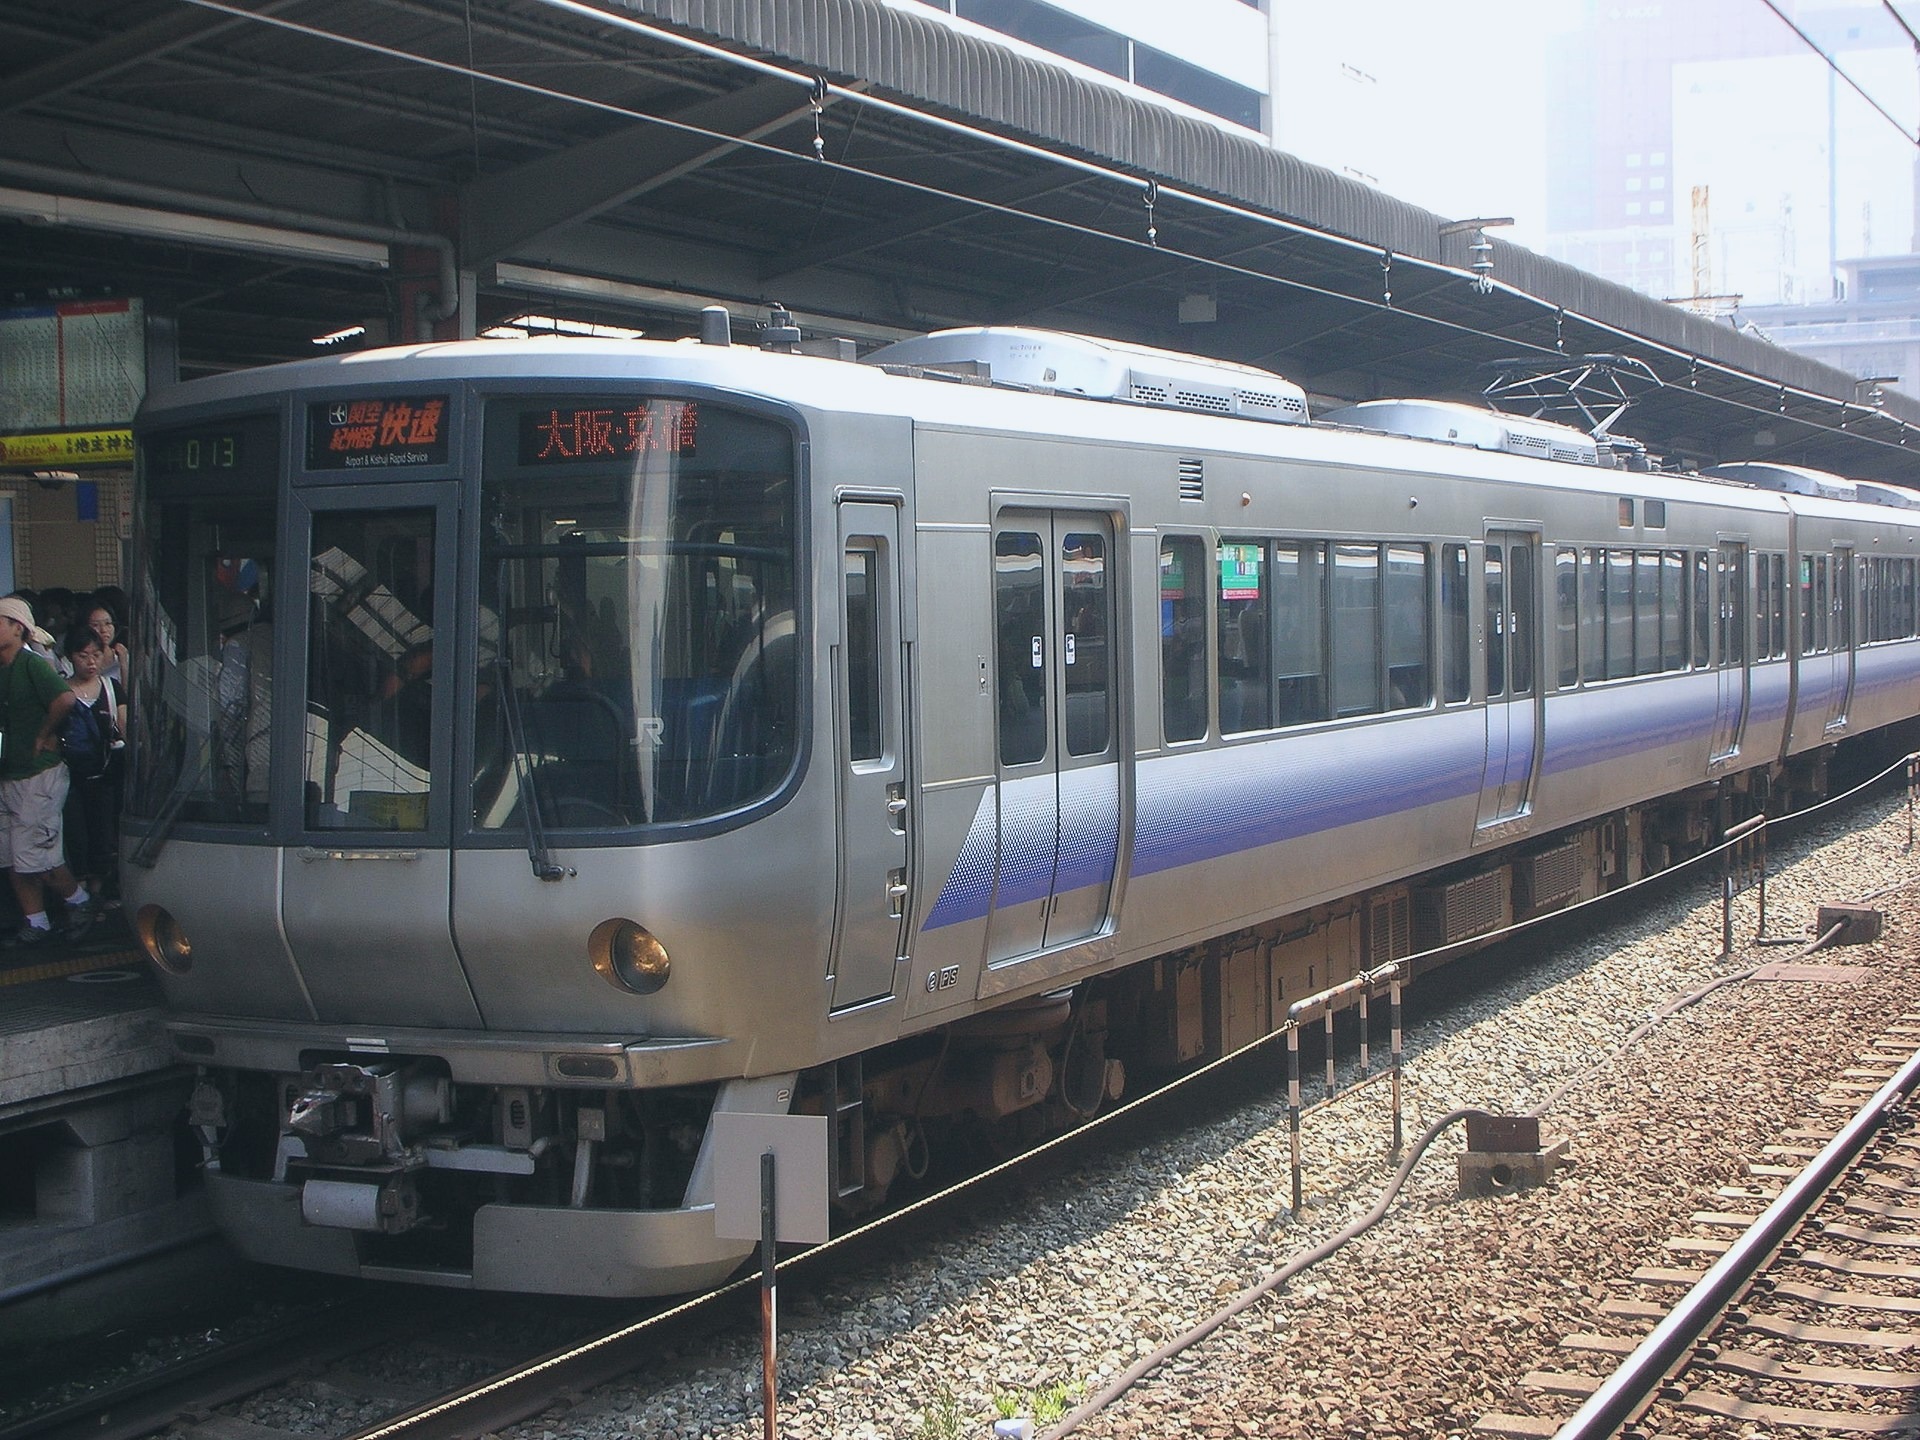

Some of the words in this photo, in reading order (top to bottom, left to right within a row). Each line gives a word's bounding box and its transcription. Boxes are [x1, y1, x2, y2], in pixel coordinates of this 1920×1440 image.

[380, 400, 444, 446] 快速
[345, 456, 363, 468] Airport
[390, 452, 406, 464] Rapid
[407, 452, 429, 463] Service
[630, 717, 665, 745] JR
[777, 1089, 790, 1103] 2
